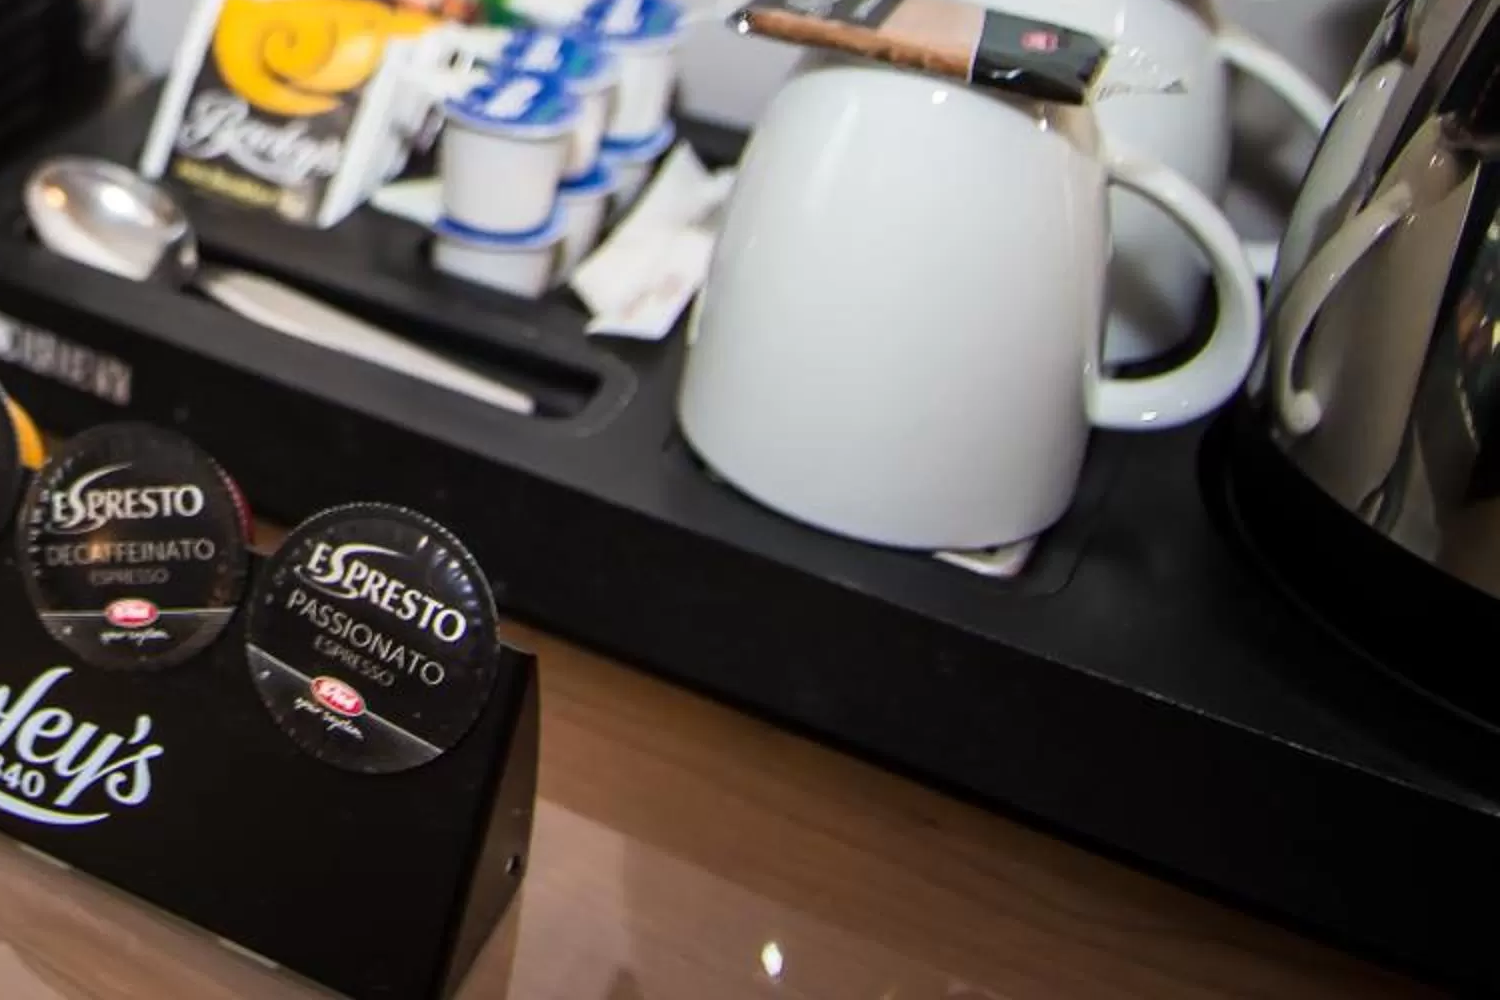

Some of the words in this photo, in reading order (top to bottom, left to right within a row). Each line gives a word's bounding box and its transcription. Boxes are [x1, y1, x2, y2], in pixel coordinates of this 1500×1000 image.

[47, 462, 204, 535] ESPRESTO
[46, 538, 215, 567] DECAFFEINATO
[294, 542, 466, 642] ESPRESTO
[286, 589, 445, 686] PASSIONATO
